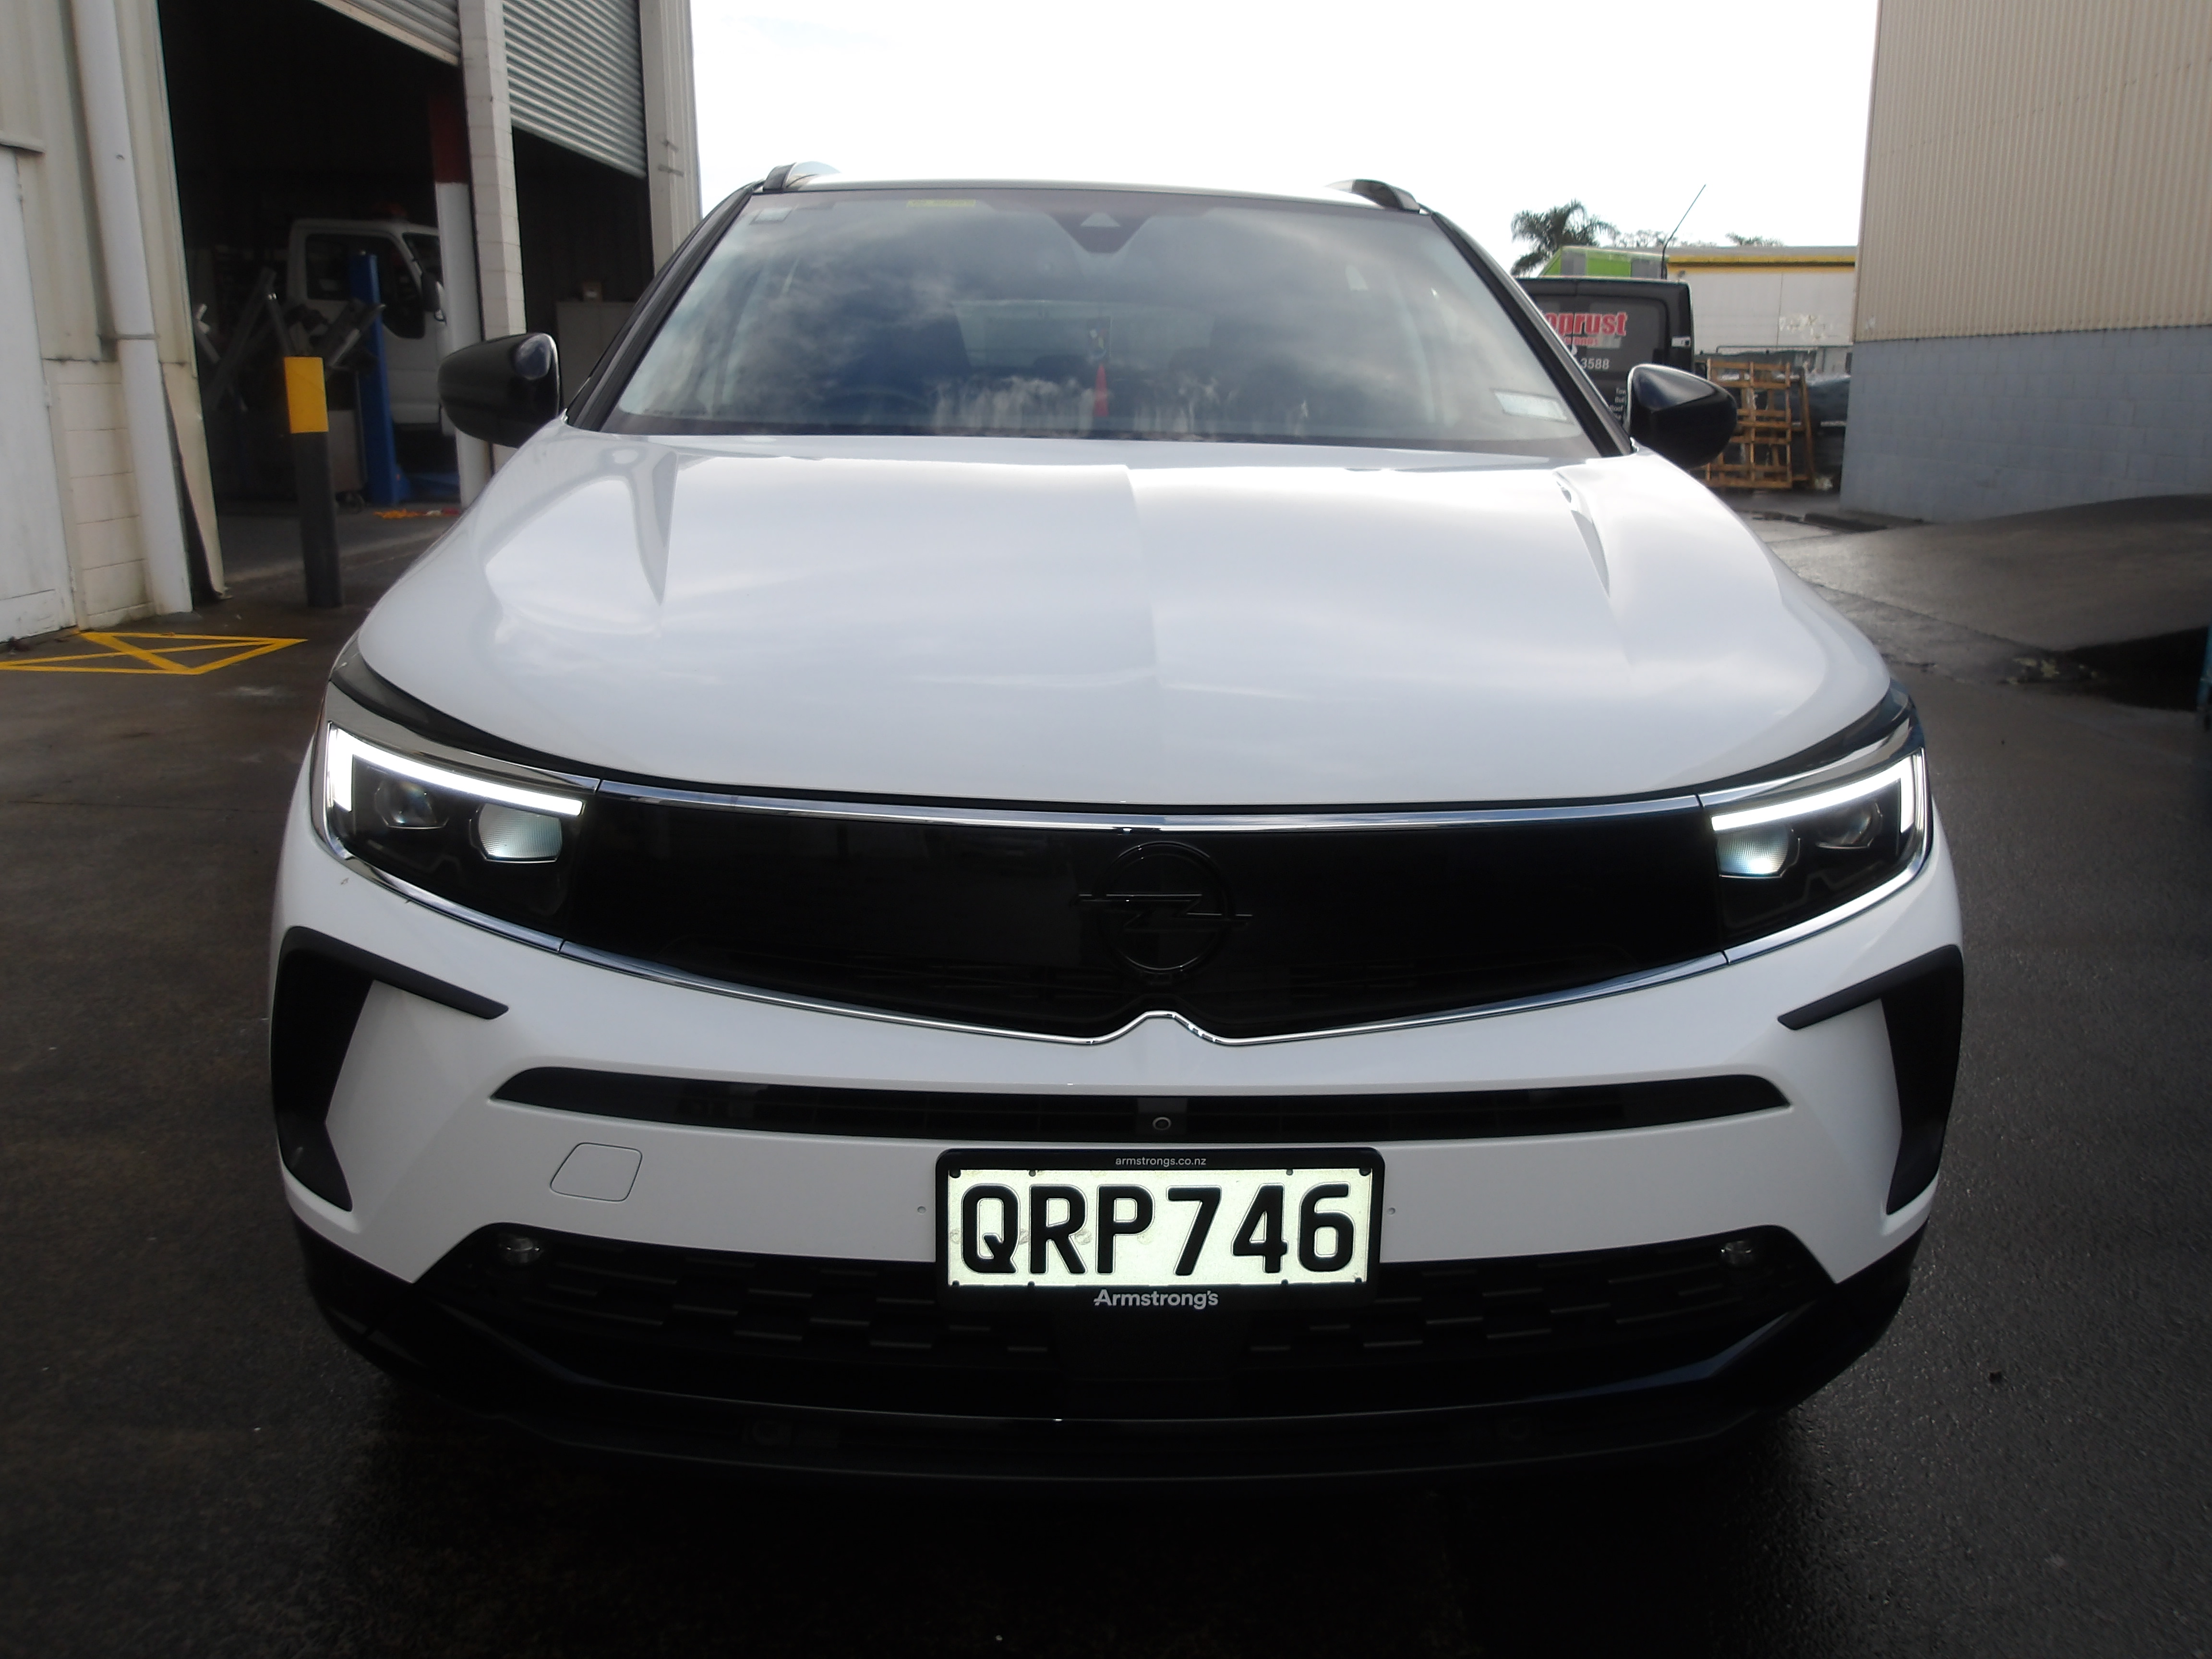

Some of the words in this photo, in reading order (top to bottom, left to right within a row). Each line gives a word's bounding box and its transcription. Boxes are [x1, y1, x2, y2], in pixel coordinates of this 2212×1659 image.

[1541, 312, 1628, 336] oprust
[1115, 1156, 1206, 1167] armstrongs.co.nz
[961, 1182, 1355, 1275] QRP746
[1093, 1289, 1219, 1310] Armstrong's
